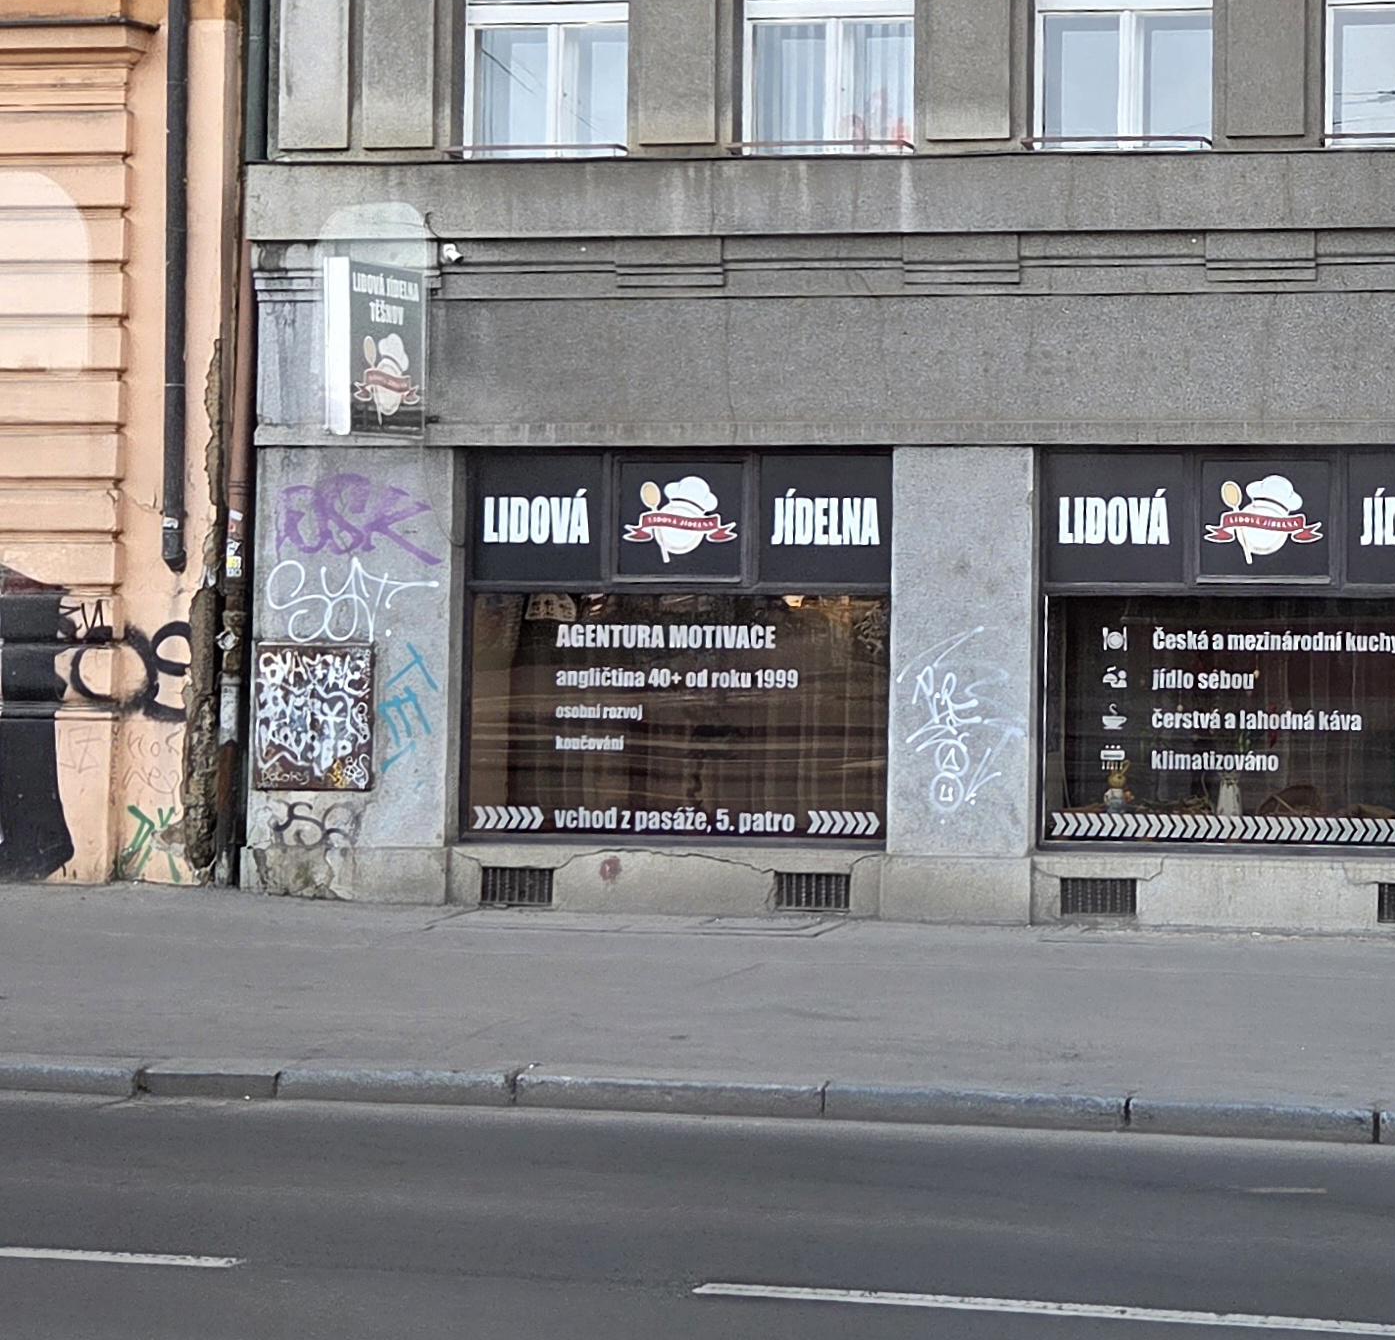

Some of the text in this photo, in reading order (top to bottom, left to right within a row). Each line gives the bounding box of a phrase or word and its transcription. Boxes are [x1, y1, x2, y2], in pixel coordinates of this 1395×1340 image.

[483, 488, 880, 546] LIDOVÁ JÍDELNA
[1058, 488, 1170, 546] LIDOVÁ
[556, 624, 776, 649] AGENTURA MOTIVACE
[1152, 626, 1209, 651] Česká
[1212, 633, 1224, 651] a
[1227, 629, 1342, 653] mezinárodní
[556, 667, 799, 689] angličtina 40+ od roku 1999
[1151, 668, 1194, 690] jídlo
[555, 703, 643, 721] osobní rozvoj
[1151, 708, 1362, 732] čerstvá a lahodná káva
[555, 734, 625, 751] koučování
[1151, 749, 1279, 772] klimatizováno
[554, 805, 796, 833] vchod z pasáže, 5. patro
